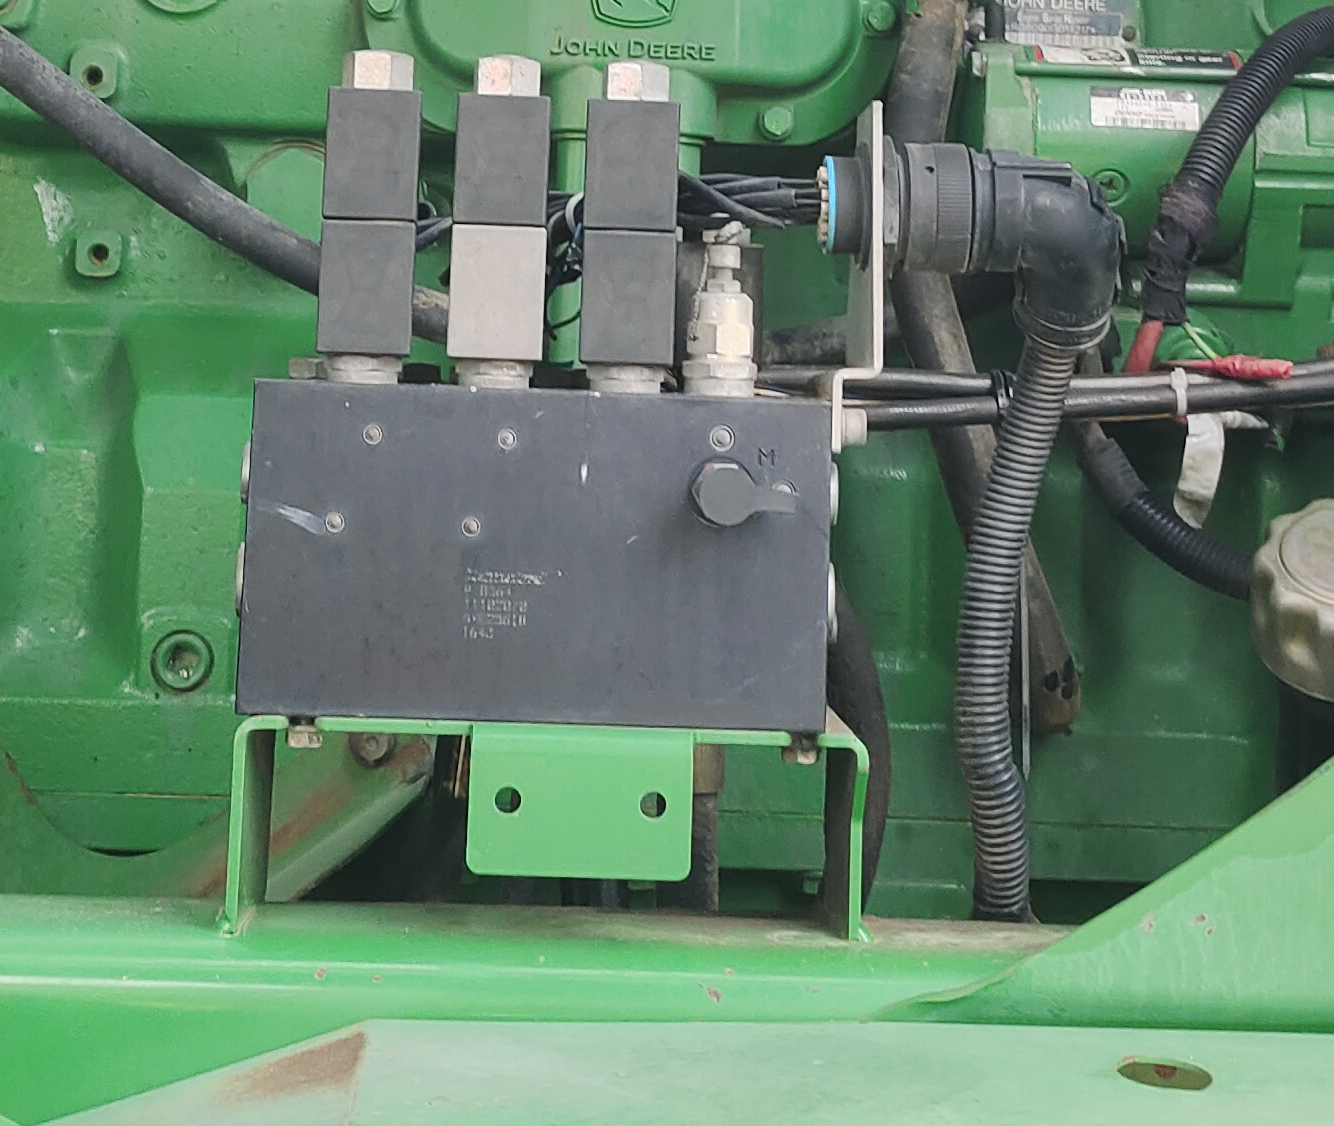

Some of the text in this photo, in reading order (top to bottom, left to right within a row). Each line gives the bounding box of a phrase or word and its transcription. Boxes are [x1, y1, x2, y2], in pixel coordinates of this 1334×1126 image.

[549, 35, 717, 62] JOHN DEERE
[757, 446, 776, 467] M
